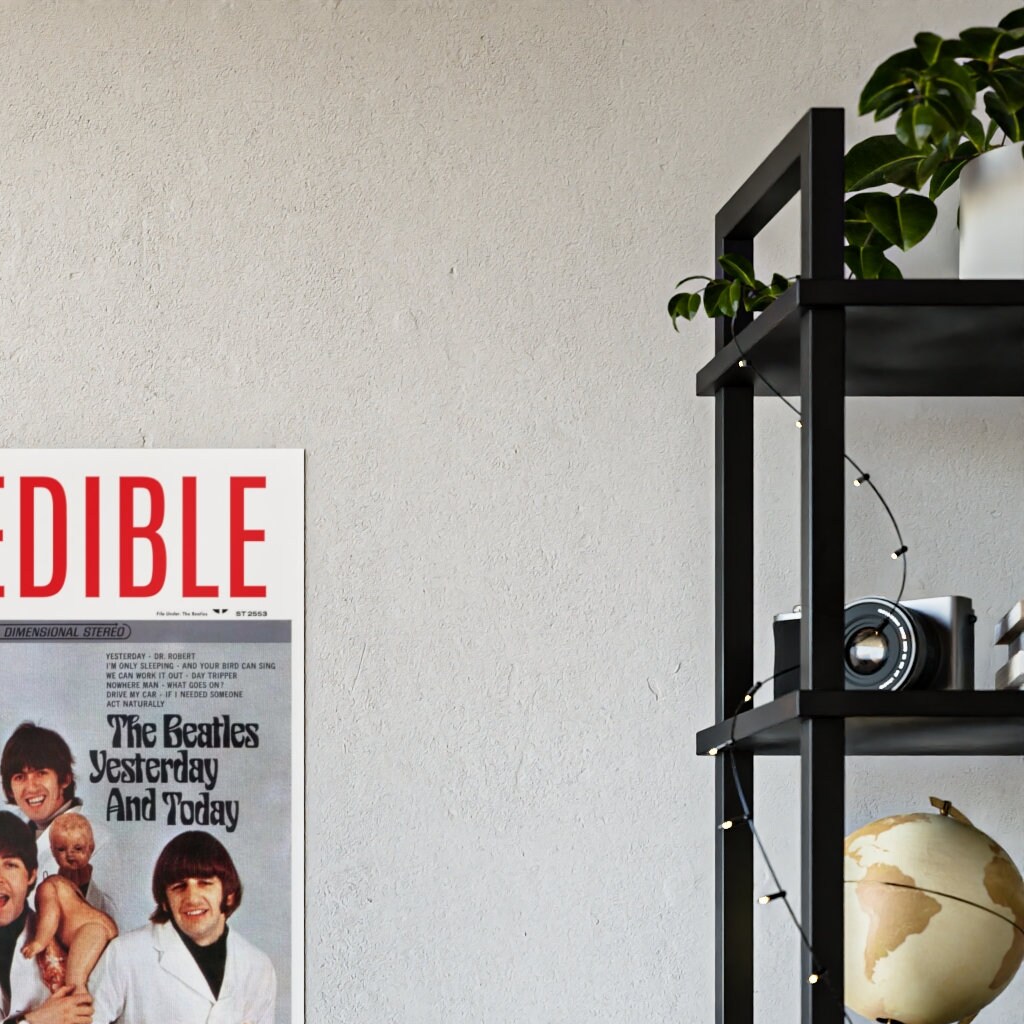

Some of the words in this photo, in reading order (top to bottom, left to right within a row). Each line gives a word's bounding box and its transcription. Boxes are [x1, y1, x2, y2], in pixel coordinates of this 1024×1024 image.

[4, 627, 80, 638] DIMENSIONAL
[83, 627, 125, 638] STEREO
[107, 714, 157, 748] The
[163, 714, 259, 748] Beatles
[89, 750, 218, 790] Yesterday
[106, 788, 156, 821] And
[162, 792, 239, 833] Today
